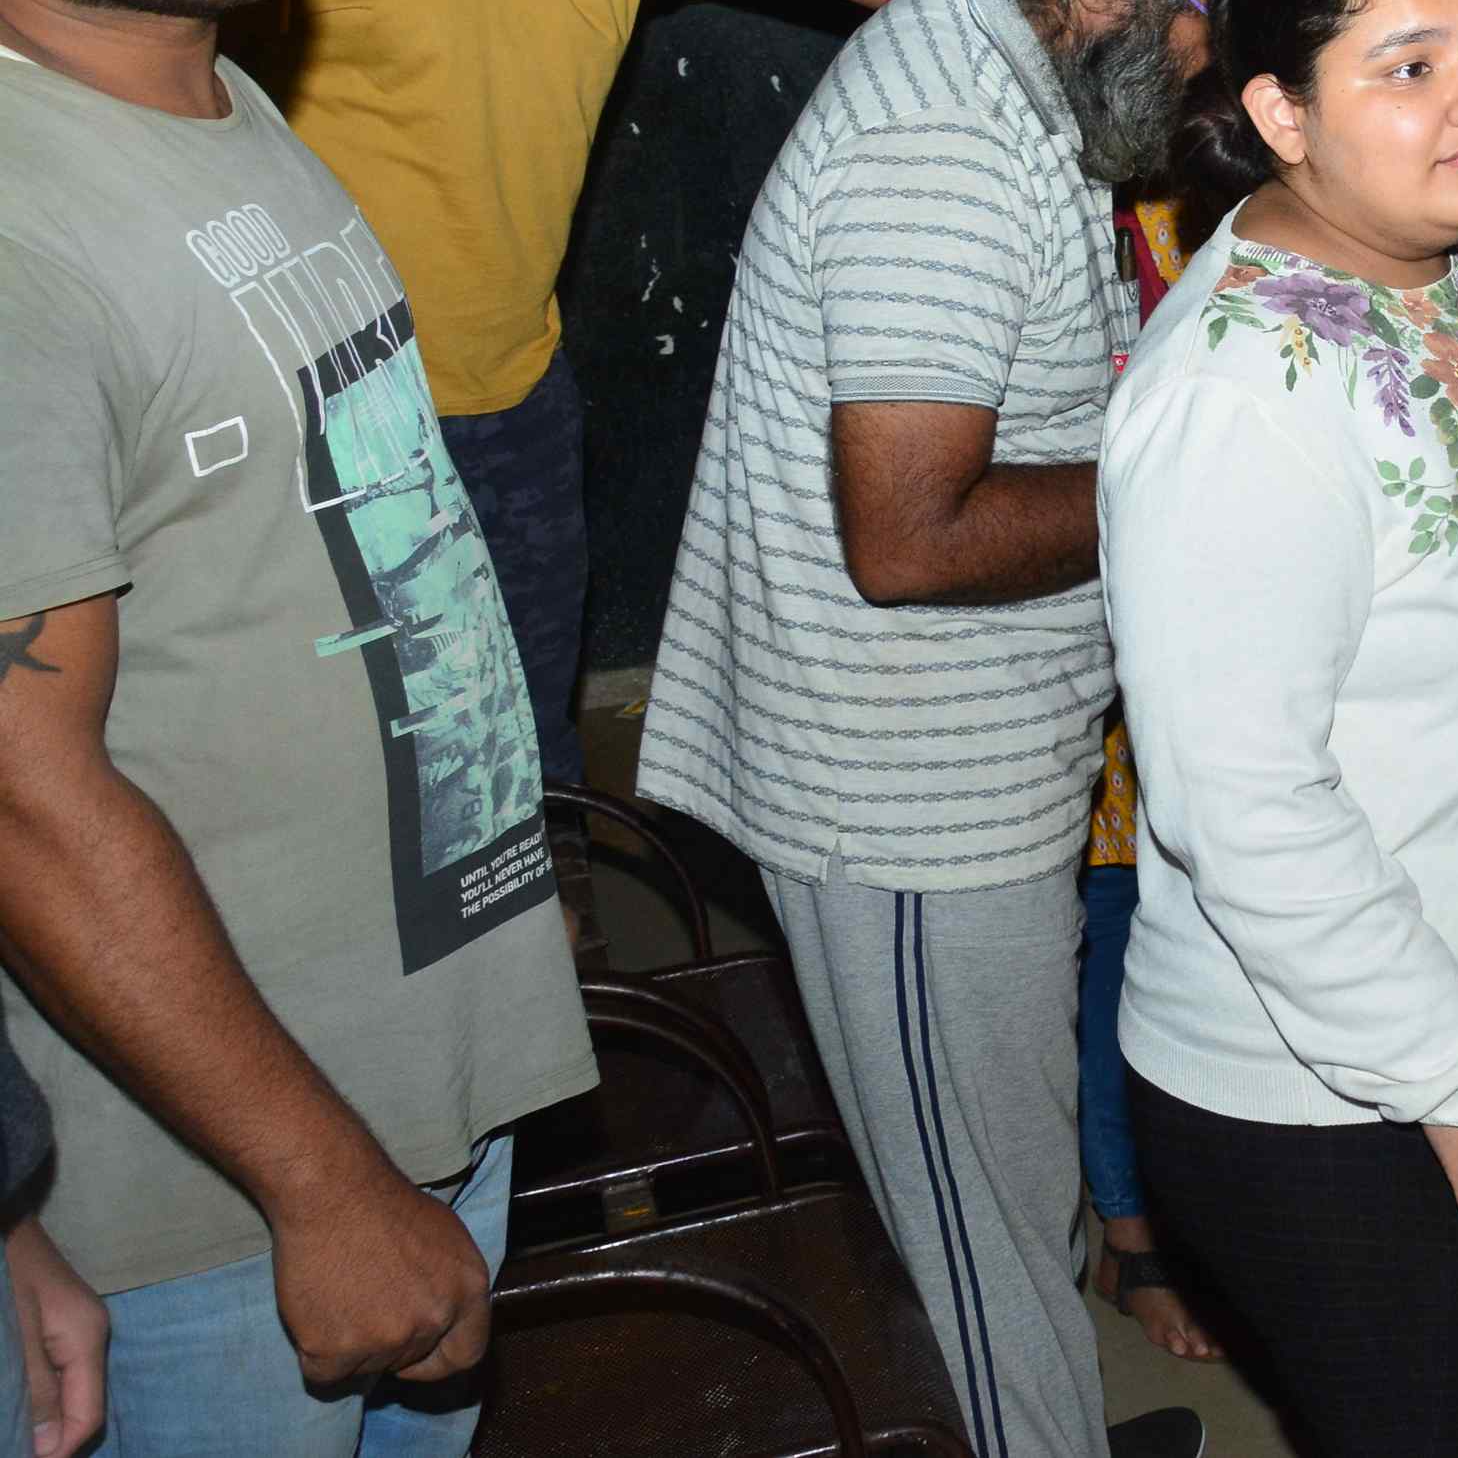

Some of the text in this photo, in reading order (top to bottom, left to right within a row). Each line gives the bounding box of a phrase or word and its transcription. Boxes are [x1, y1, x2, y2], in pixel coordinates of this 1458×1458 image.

[185, 203, 292, 287] GOOD
[460, 864, 489, 888] UNTIL
[490, 844, 518, 871] YOU'RE
[460, 879, 494, 903] YOU'LL
[494, 860, 523, 886] NEVER
[523, 846, 545, 868] HAVE
[460, 900, 482, 919] THE
[481, 869, 535, 909] POSSIBILITY
[535, 862, 546, 878] OF
